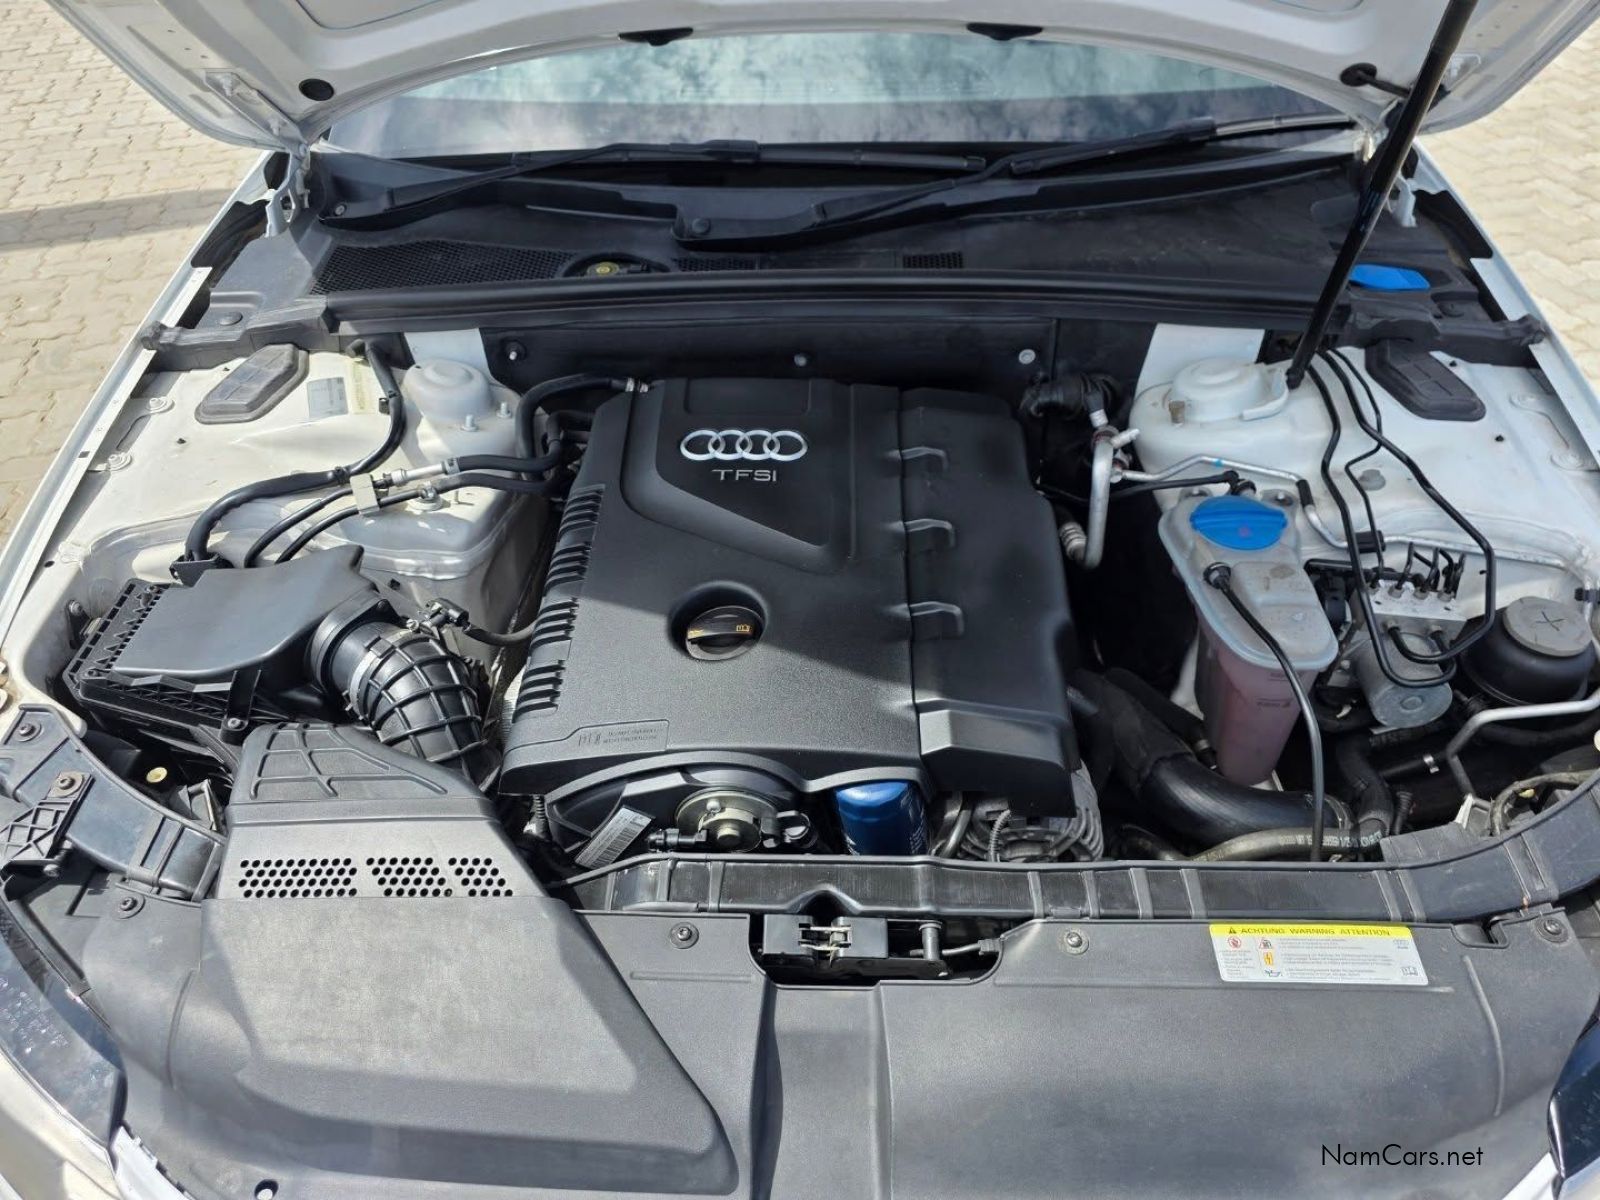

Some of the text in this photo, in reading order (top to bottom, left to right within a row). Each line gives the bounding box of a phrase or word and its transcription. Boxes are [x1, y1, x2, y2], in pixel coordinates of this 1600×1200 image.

[711, 469, 777, 482] TFSI
[1240, 927, 1392, 937] ACHTUNG WARNING ATTENTION
